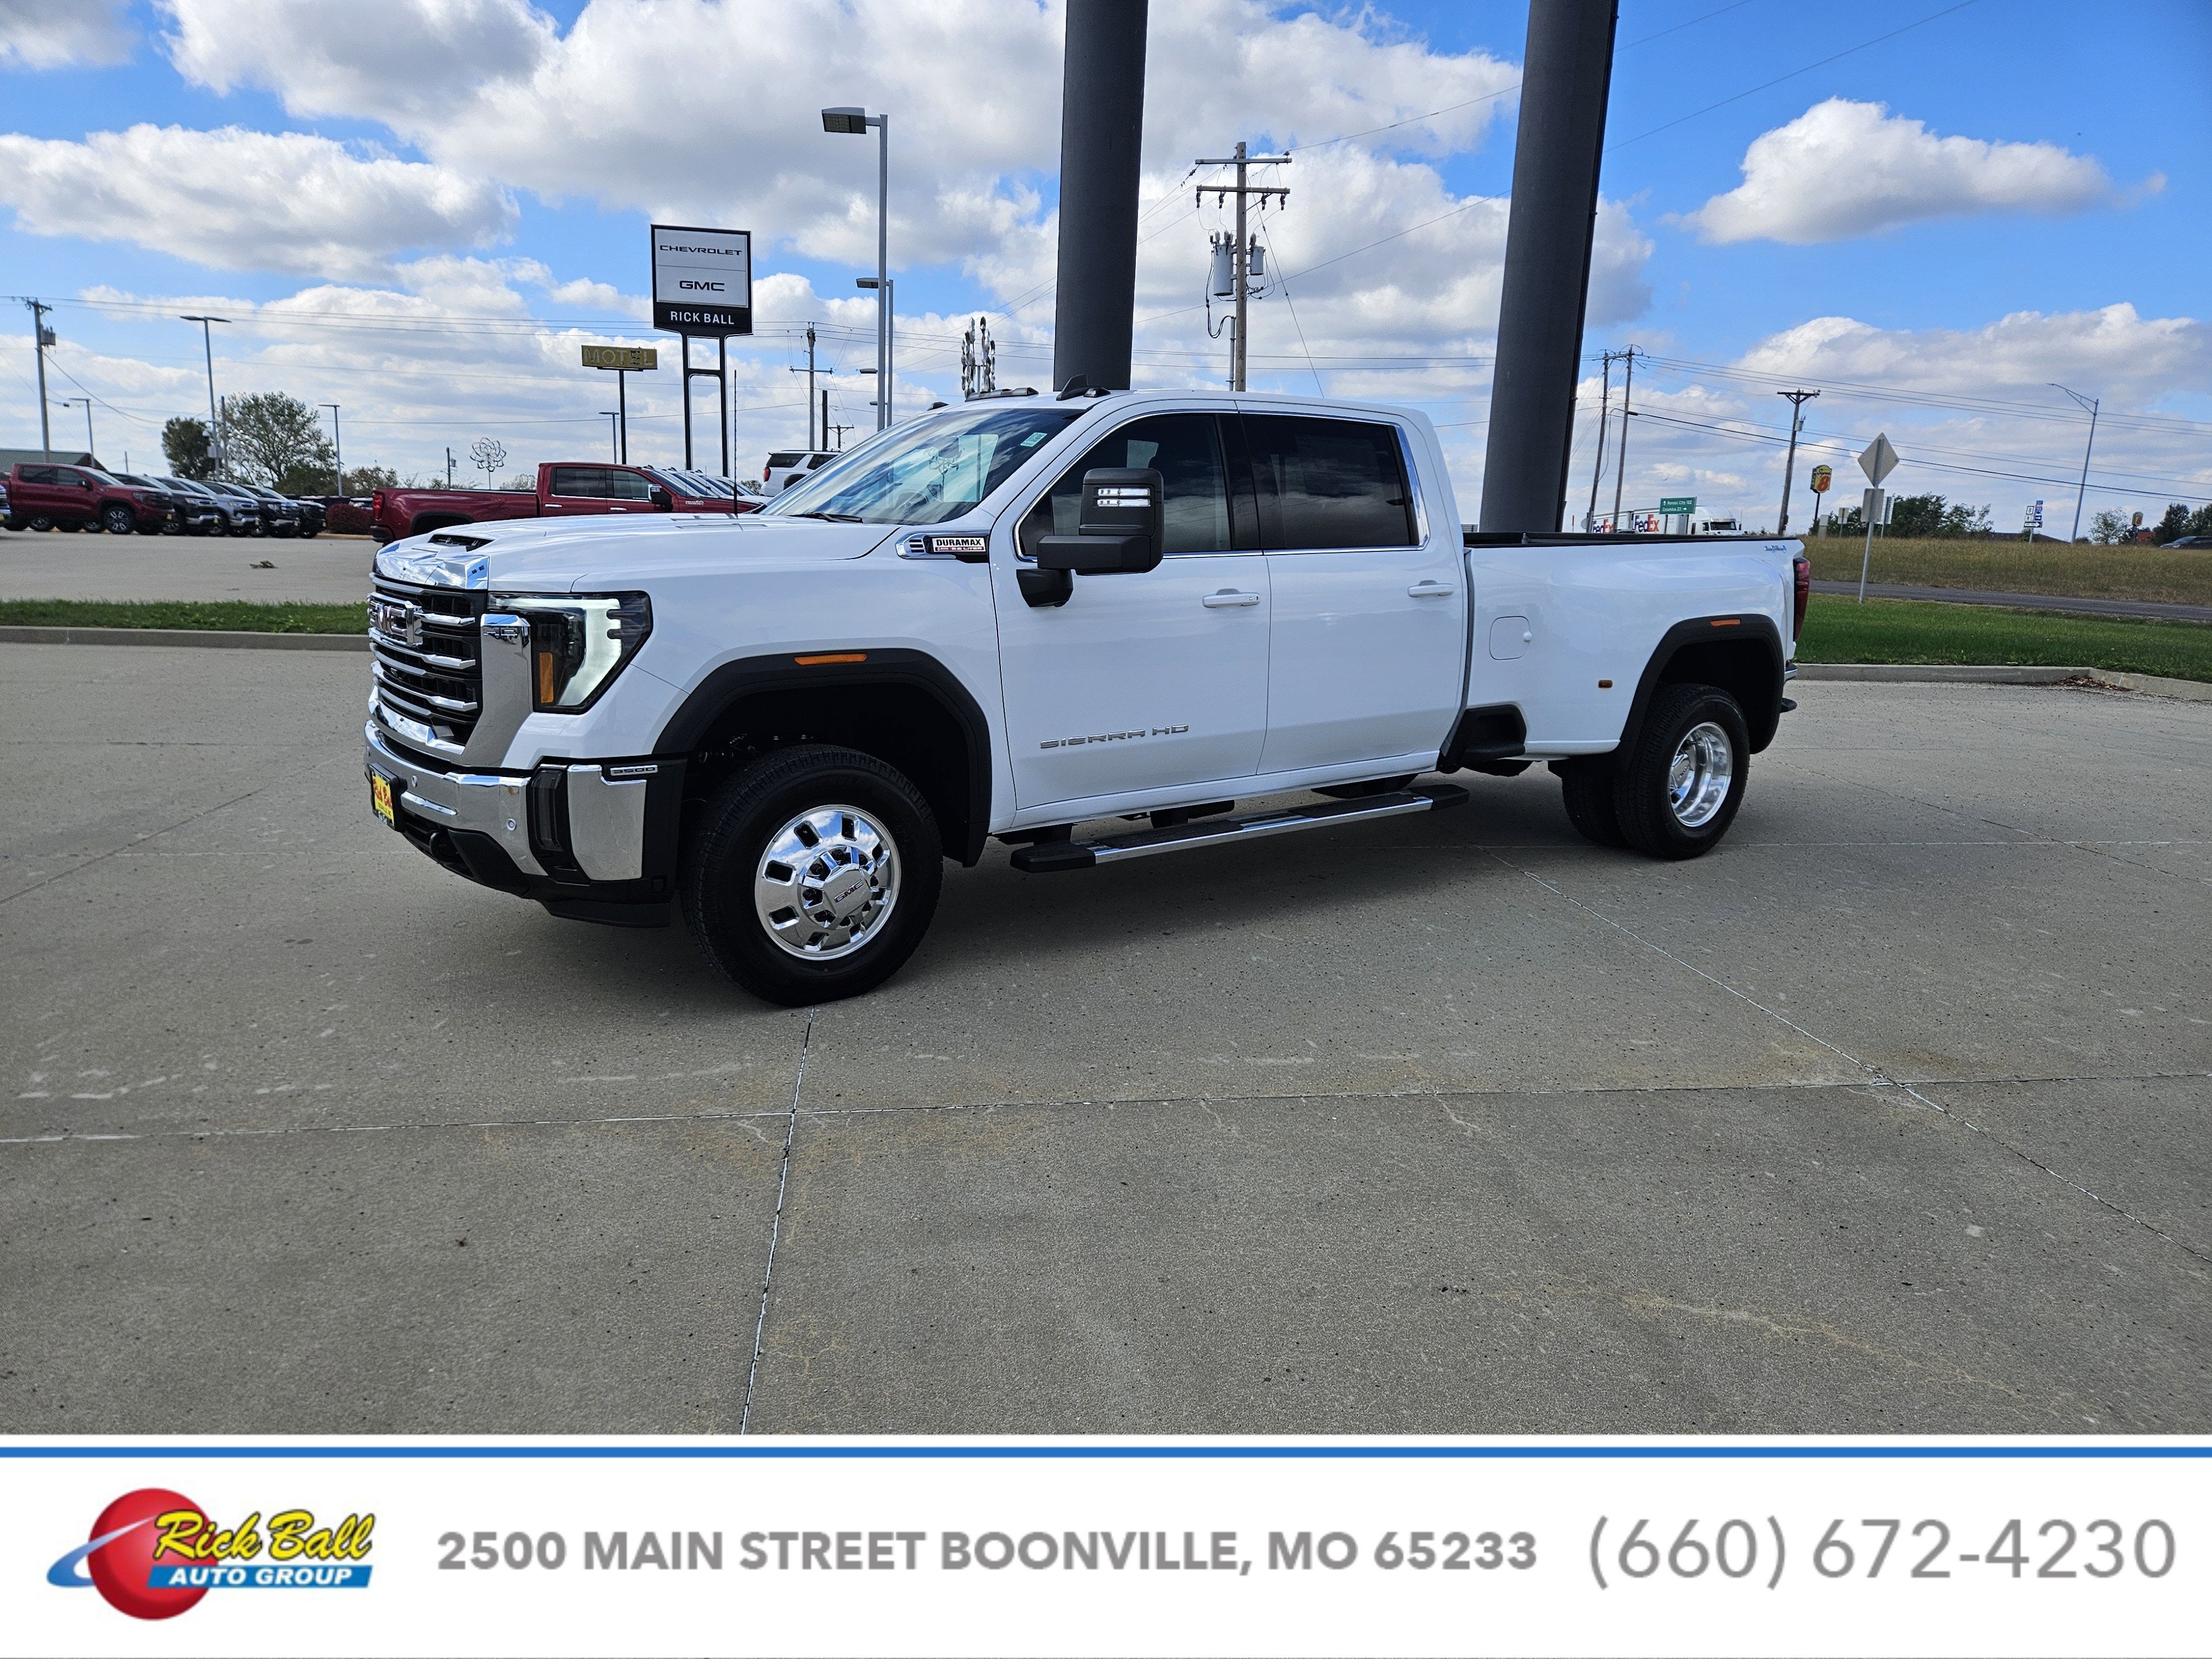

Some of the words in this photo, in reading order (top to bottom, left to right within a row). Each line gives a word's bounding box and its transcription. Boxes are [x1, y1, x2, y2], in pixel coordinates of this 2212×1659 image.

[660, 245, 742, 255] CHEVROLET
[680, 280, 725, 291] GMC
[670, 311, 700, 322] RICK
[704, 313, 734, 325] BALL
[584, 348, 654, 366] MOTEL
[1817, 476, 1830, 492] 8
[1635, 514, 1660, 533] FedEx
[1040, 729, 1146, 749] SIERRA
[1152, 724, 1189, 735] HD
[834, 879, 864, 903] GMC
